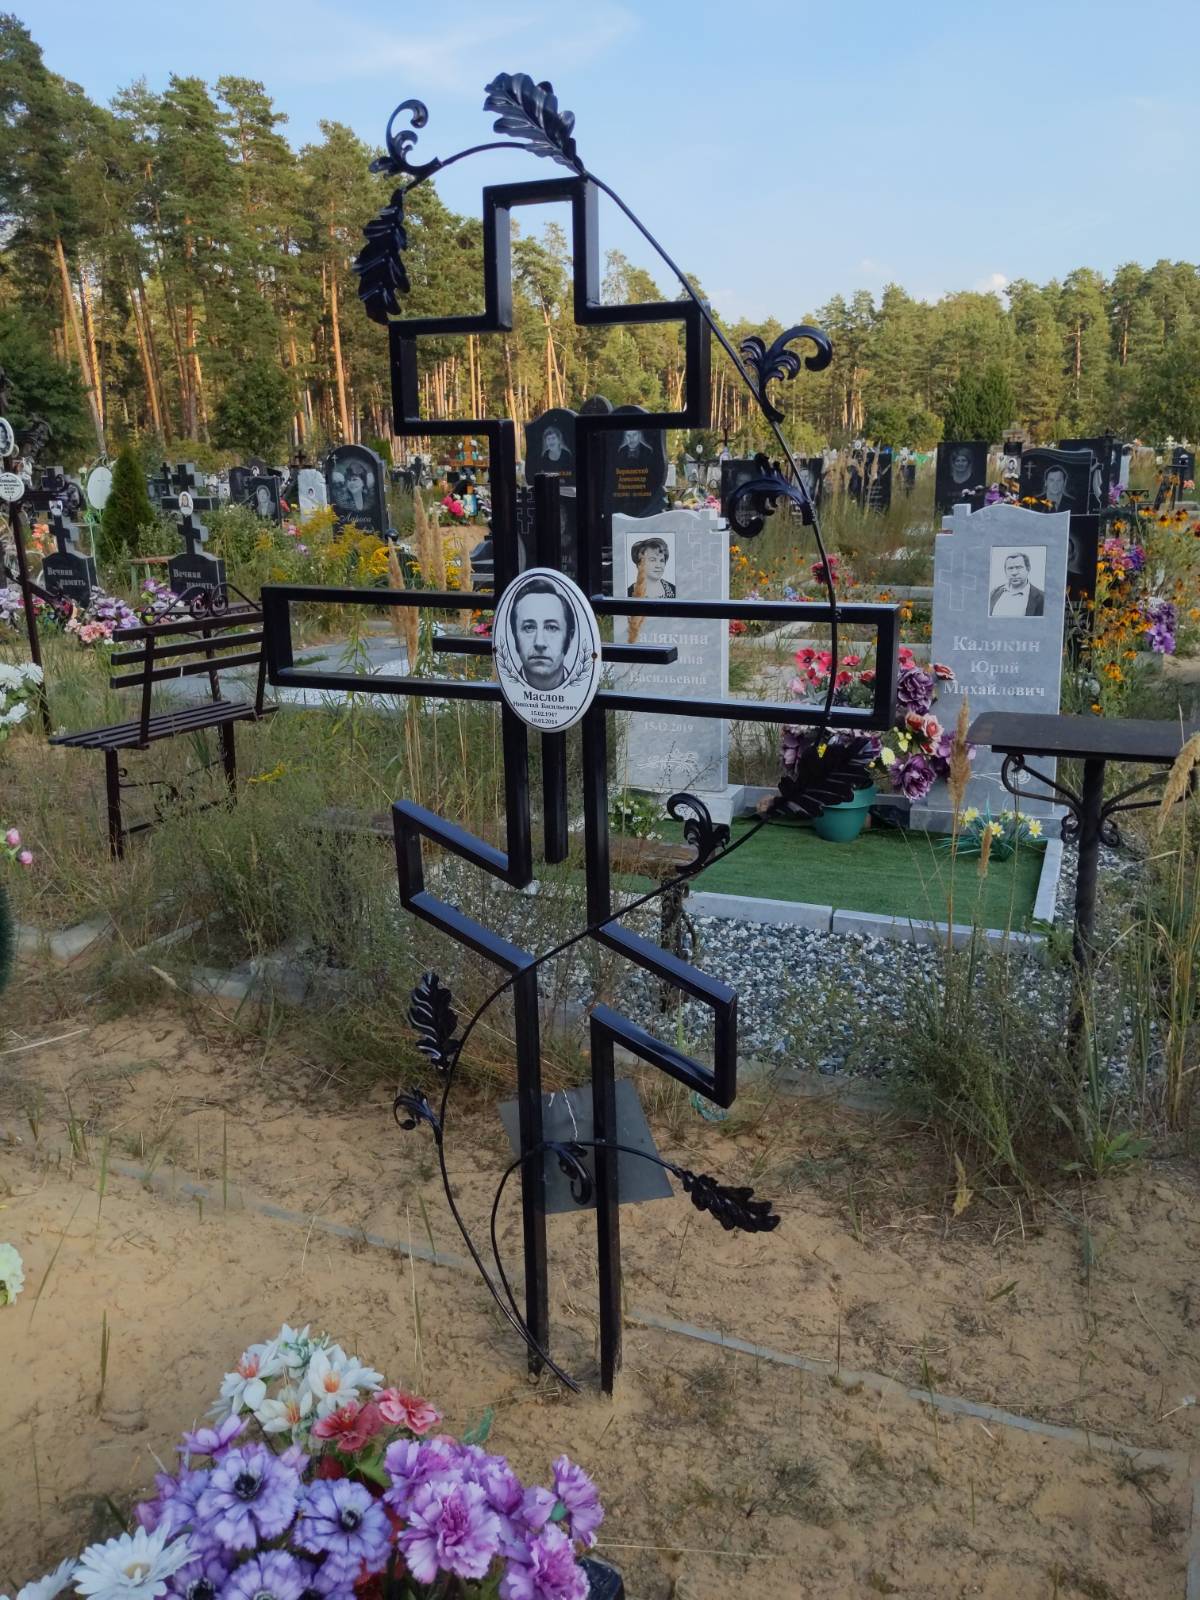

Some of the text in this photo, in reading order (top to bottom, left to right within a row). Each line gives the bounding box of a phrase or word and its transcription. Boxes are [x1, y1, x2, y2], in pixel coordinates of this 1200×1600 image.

[47, 566, 73, 576] Вечная
[172, 568, 202, 579] Вечная
[633, 631, 709, 645] алякина
[952, 635, 1041, 653] Калякин
[970, 660, 1020, 677] Юрий
[629, 671, 708, 685] Васильевна
[943, 680, 1046, 698] Михайлович
[523, 690, 565, 703] Маслов
